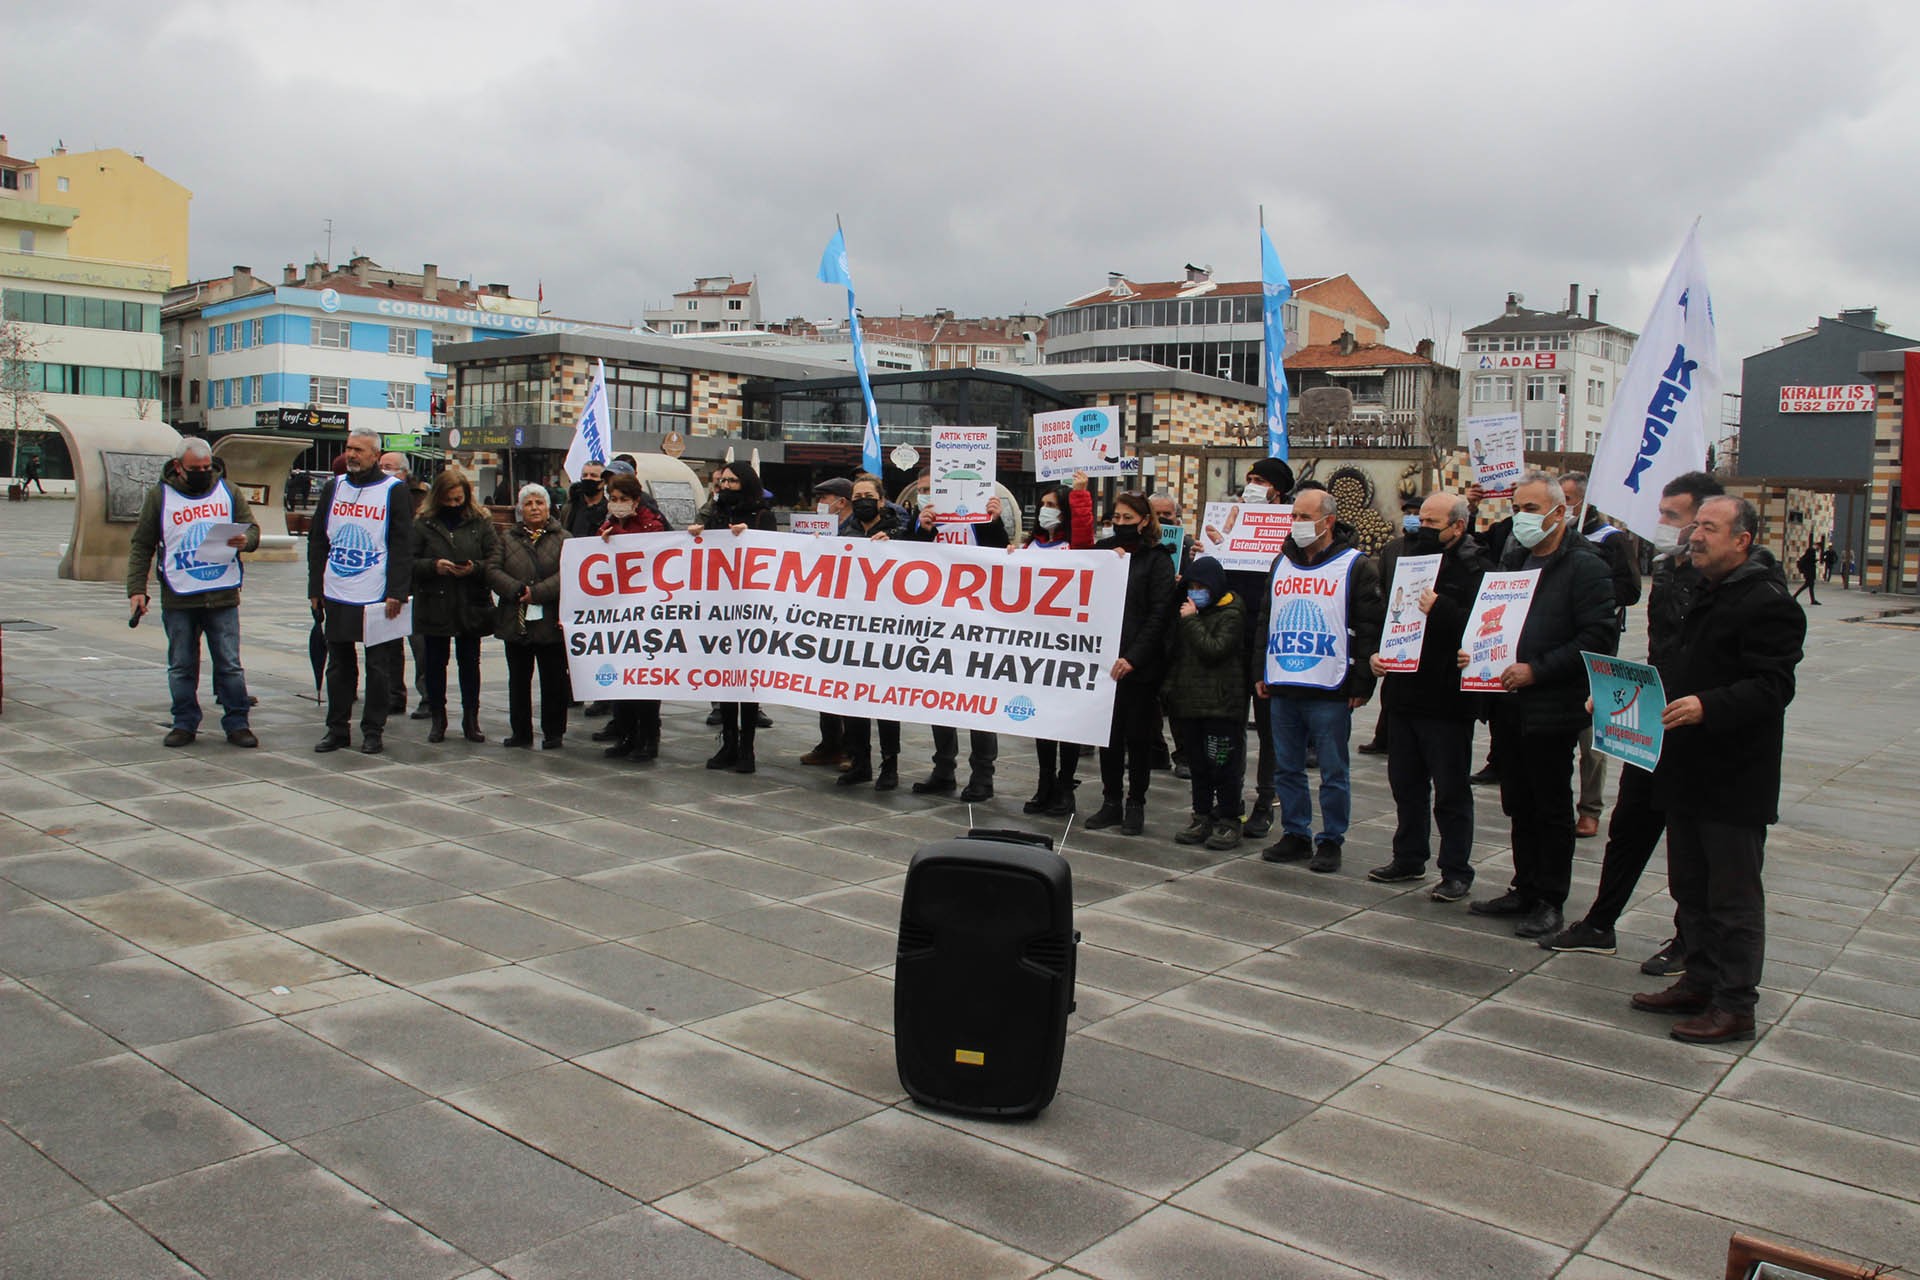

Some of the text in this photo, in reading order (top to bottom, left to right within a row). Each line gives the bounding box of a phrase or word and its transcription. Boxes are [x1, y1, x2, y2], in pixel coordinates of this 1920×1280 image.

[1499, 356, 1533, 368] ADA
[1781, 386, 1843, 400] KİRALIK
[1847, 385, 1865, 400] İŞ
[1780, 401, 1789, 412] 0
[1793, 400, 1821, 412] 532
[1826, 400, 1855, 411] 670
[320, 413, 346, 425] mekan
[1082, 412, 1098, 423] artık
[1623, 343, 1698, 494] KESK
[1041, 420, 1071, 433] insanca
[939, 431, 988, 441] ARTIK YETER!
[1037, 431, 1074, 450] yaşamak
[935, 441, 992, 452] Geçinemiyoruz.
[1041, 447, 1073, 462] istiyoruz
[1243, 512, 1293, 525] kuru ekmek
[578, 536, 1095, 623] GEÇİNEMİYORUZ!
[1487, 578, 1530, 590] ARTIK YETER!
[573, 601, 1103, 654] ZAMLAR GERİ ALINSIN, ÜCRETLERİMİZ ARTTIRILSIN!
[1268, 631, 1337, 657] KESK
[570, 628, 1100, 692] SAVAŞA ve YOKSULLUĞA HAYIR!
[622, 667, 999, 716] KESK ÇORUM ŞUBELER PLATFORMU
